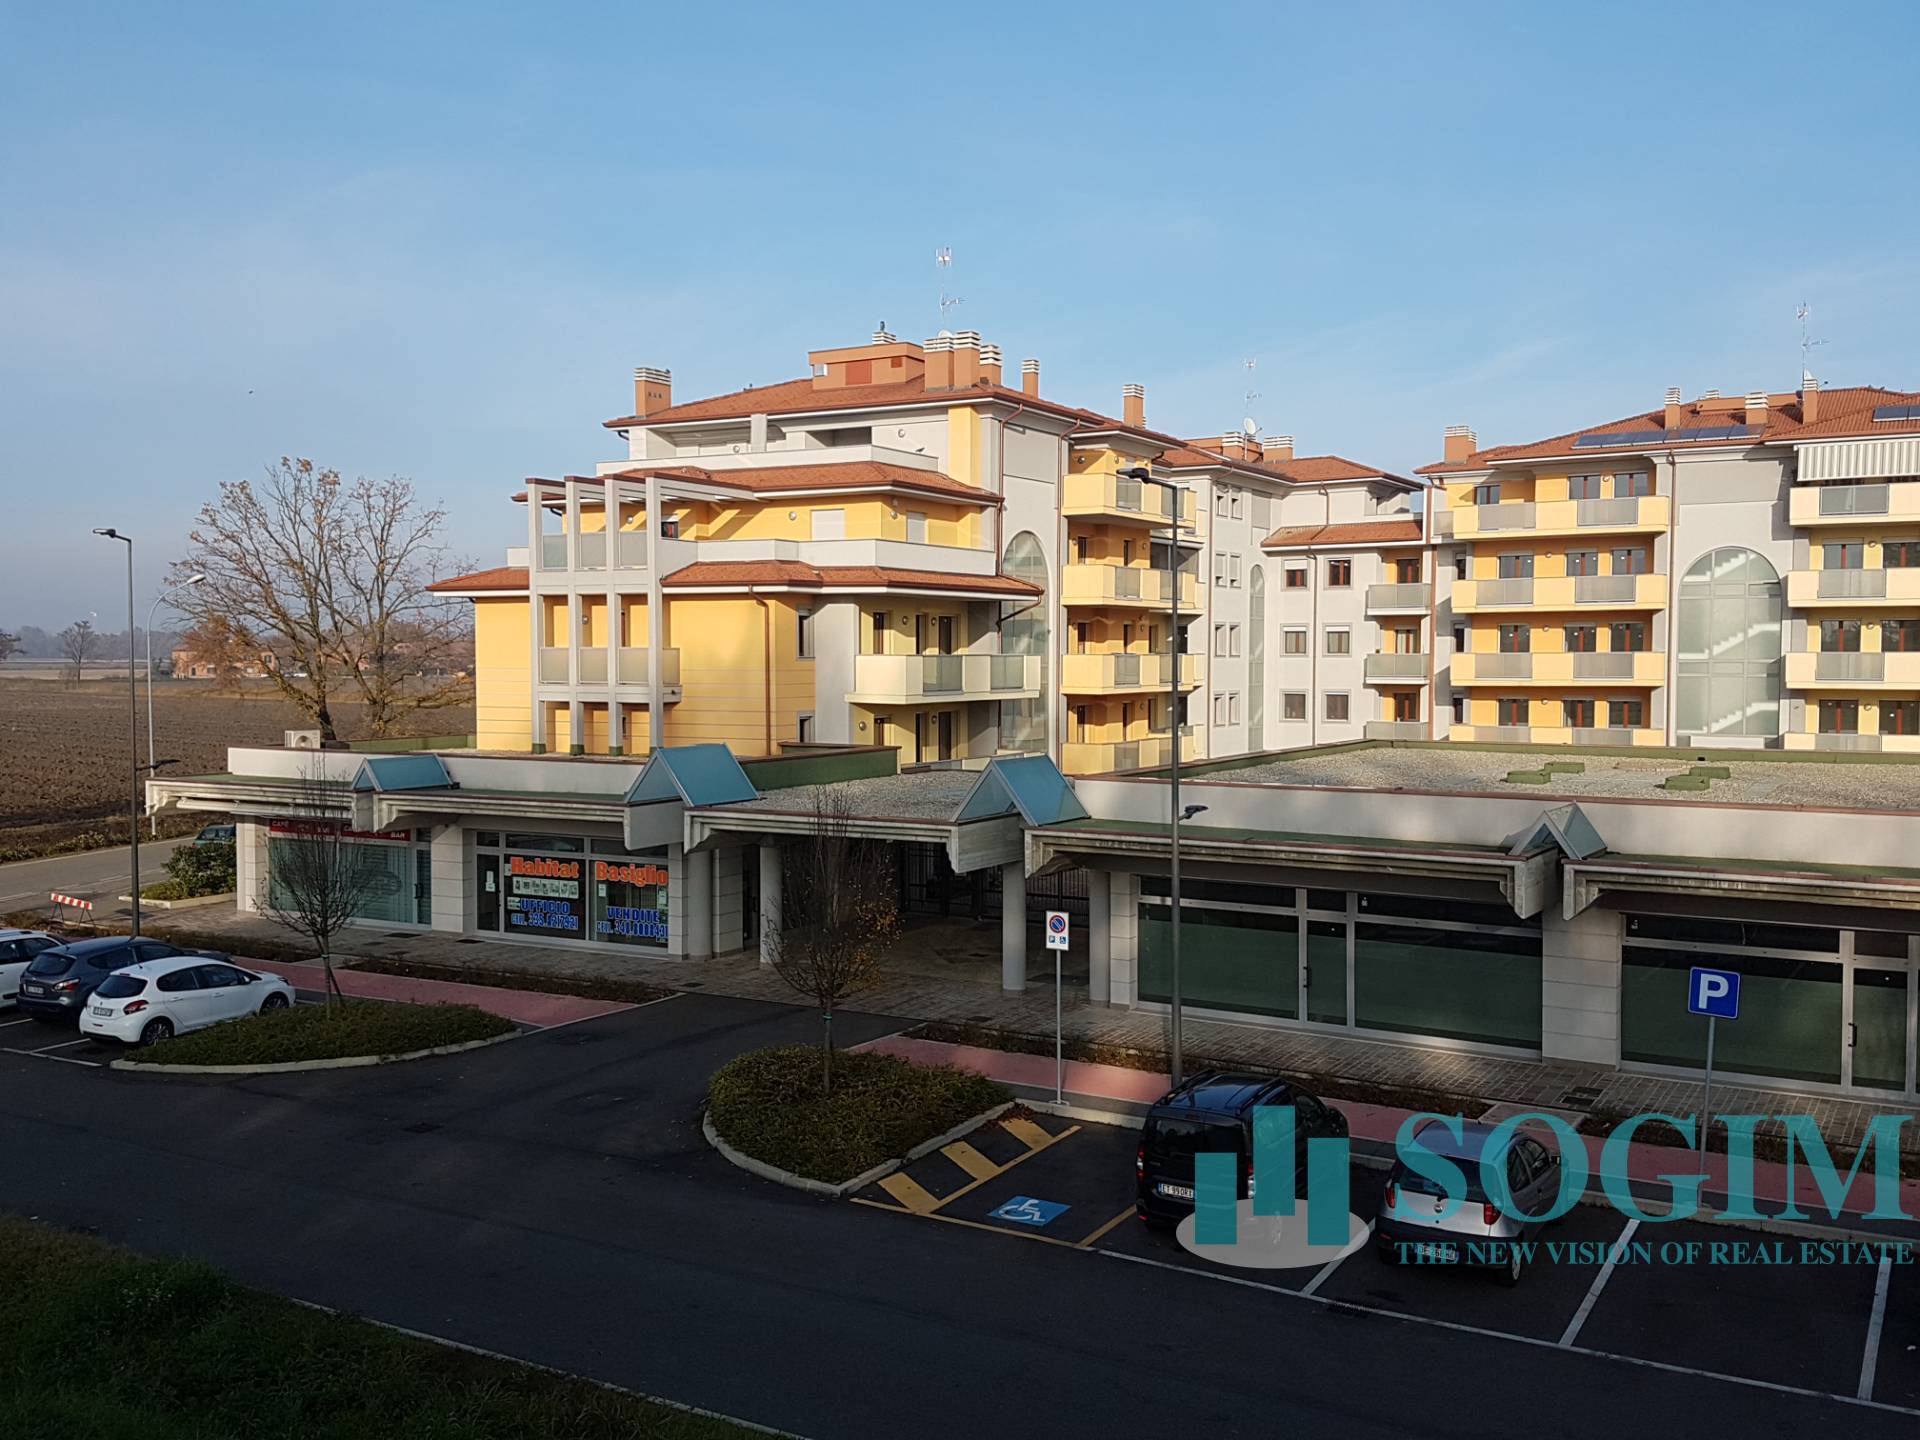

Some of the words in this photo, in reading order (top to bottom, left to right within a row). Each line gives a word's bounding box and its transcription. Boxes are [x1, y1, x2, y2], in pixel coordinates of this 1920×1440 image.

[511, 857, 579, 877] Habitat
[595, 861, 669, 887] Basiglio
[521, 899, 570, 915] UFFICIO
[607, 907, 660, 923] VENDITE
[1699, 973, 1729, 1009] P
